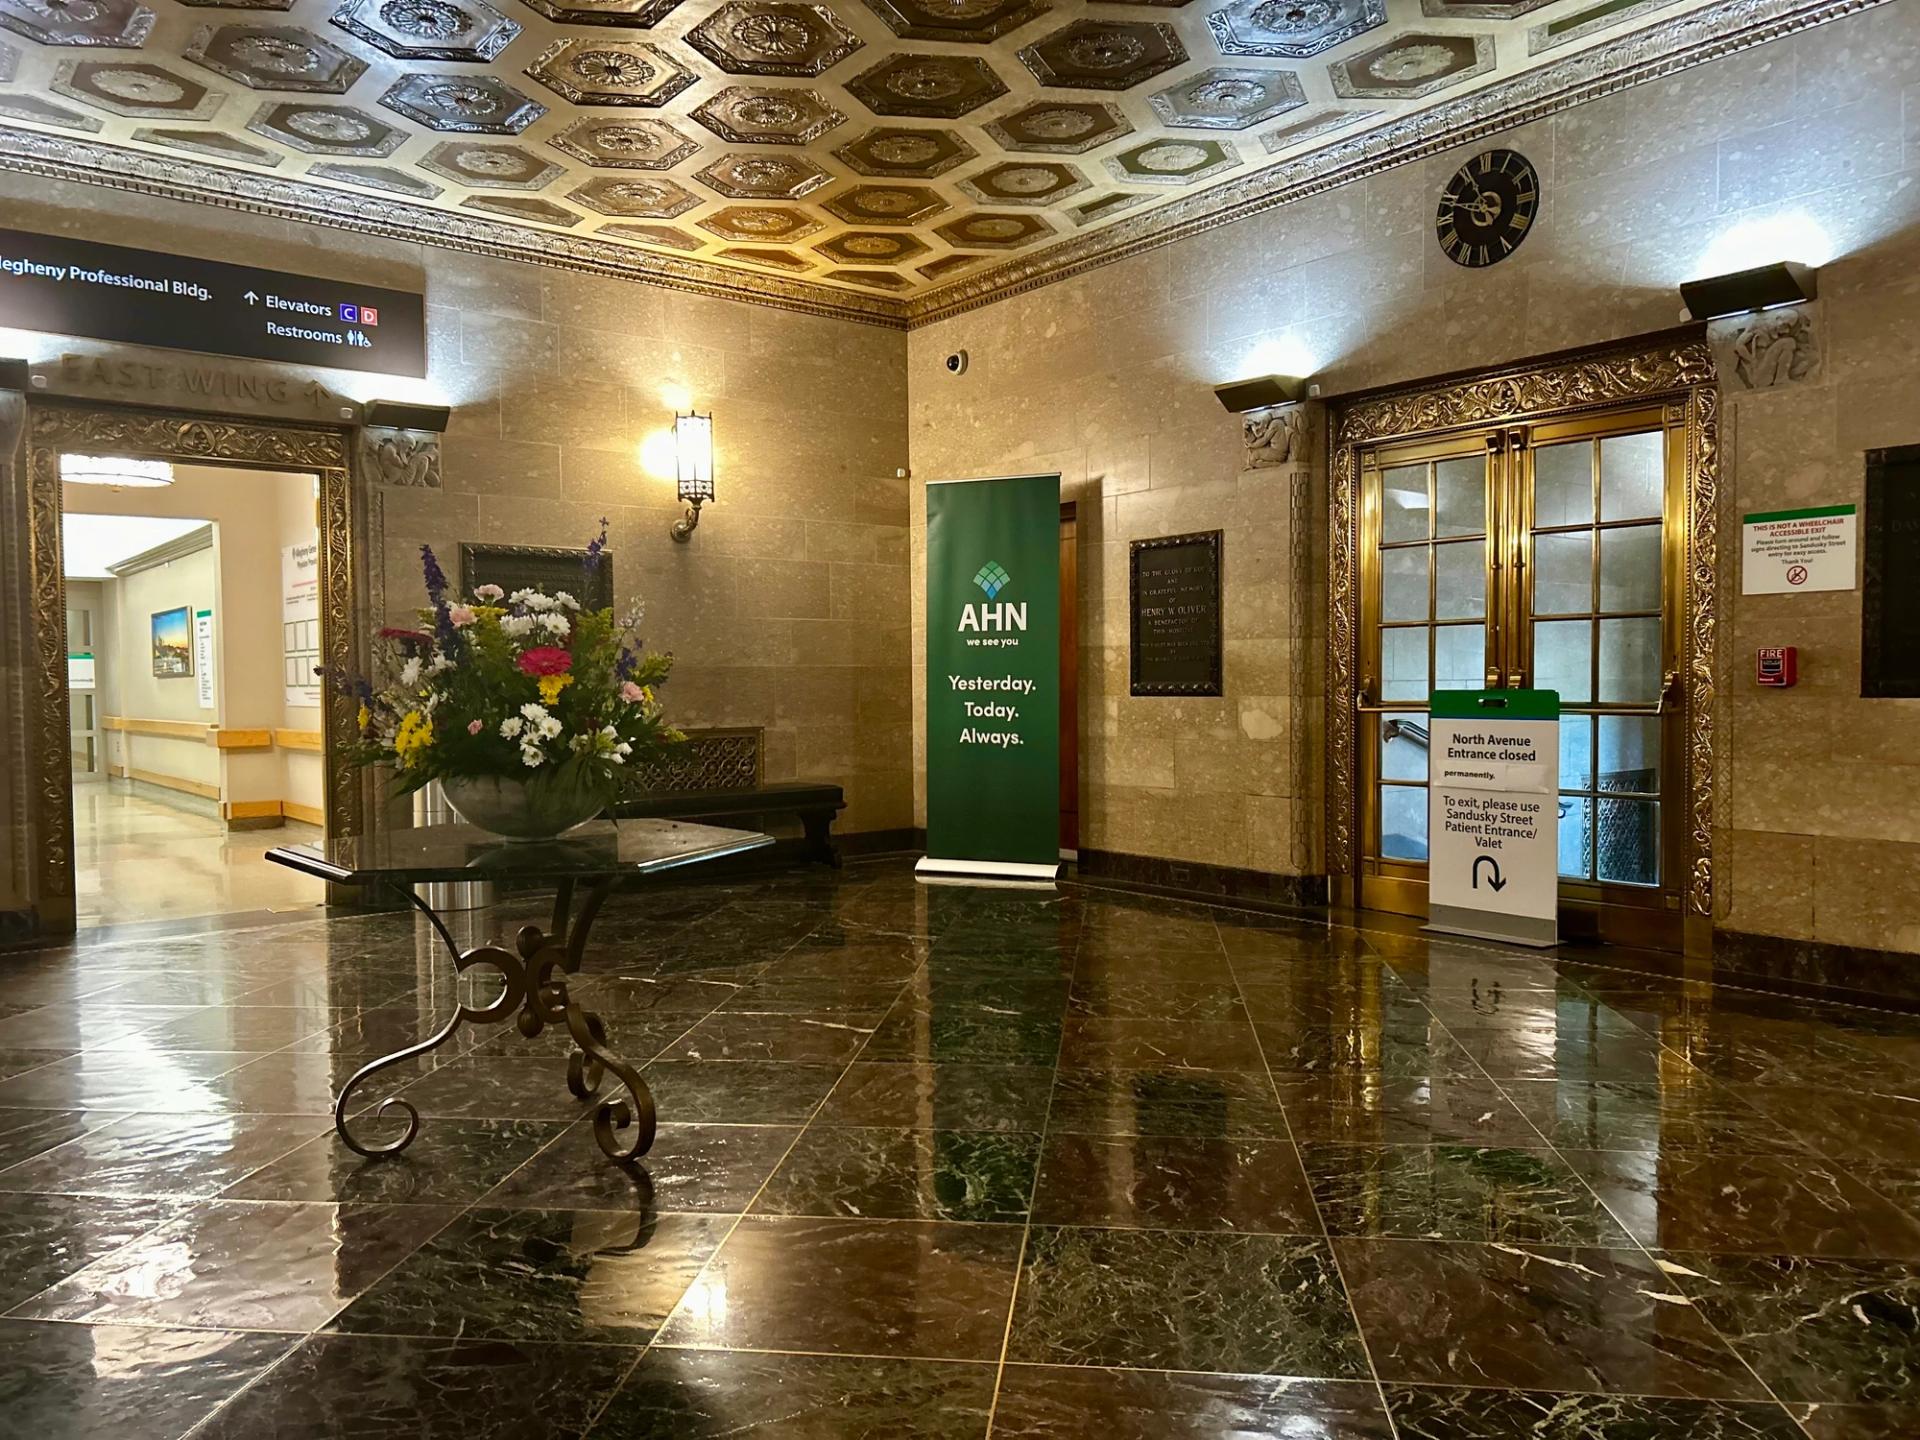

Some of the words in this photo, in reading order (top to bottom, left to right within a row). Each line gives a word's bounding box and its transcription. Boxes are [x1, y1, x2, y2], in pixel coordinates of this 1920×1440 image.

[70, 266, 168, 292] Professional
[173, 281, 212, 300] Bldg.
[266, 295, 332, 316] Elevators
[266, 322, 342, 344] Restrooms
[61, 353, 162, 389] EAST
[183, 368, 288, 402] WING
[1799, 518, 1844, 528] WHEELCHAIR
[1770, 529, 1809, 537] ACCESSIBLE
[1800, 542, 1826, 550] Sandusky
[958, 602, 1028, 632] AHN
[1141, 606, 1164, 617] HENRY
[1178, 604, 1206, 616] OLIVER
[966, 638, 980, 646] we
[982, 638, 999, 646] see
[1001, 638, 1018, 648] you
[1760, 650, 1783, 658] FIRE
[948, 675, 1036, 696] Yesterday.
[964, 702, 1020, 722] Today.
[960, 728, 1024, 748] Always.
[1452, 734, 1484, 746] North
[1487, 734, 1530, 747] Avenue
[1448, 748, 1496, 760] Entrance
[1498, 750, 1536, 762] closed
[1444, 770, 1496, 780] permanently.
[1443, 796, 1456, 806] To
[1458, 798, 1480, 810] exit,
[1482, 800, 1518, 812] please
[1520, 803, 1540, 813] use
[1446, 808, 1497, 825] Sandusky
[1500, 813, 1534, 826] Street
[1445, 821, 1482, 834] Patient
[1484, 825, 1537, 840] Entrance/
[1475, 836, 1502, 849] Valet
